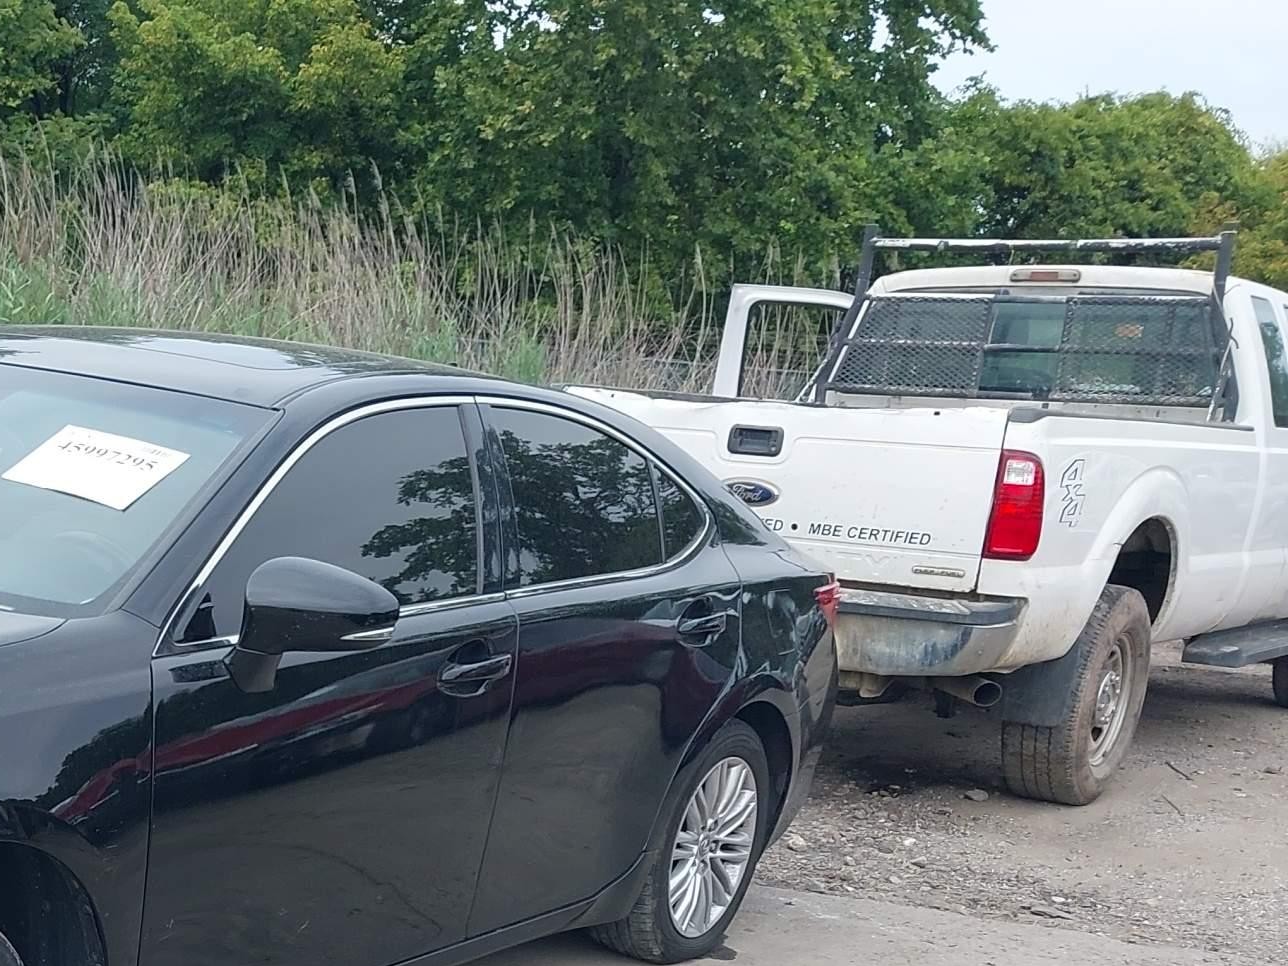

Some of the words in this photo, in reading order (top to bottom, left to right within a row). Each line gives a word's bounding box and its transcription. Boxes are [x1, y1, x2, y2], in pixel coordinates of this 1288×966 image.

[731, 483, 764, 502] Ford
[808, 522, 843, 537] MBE
[847, 525, 931, 545] CERTIFIED
